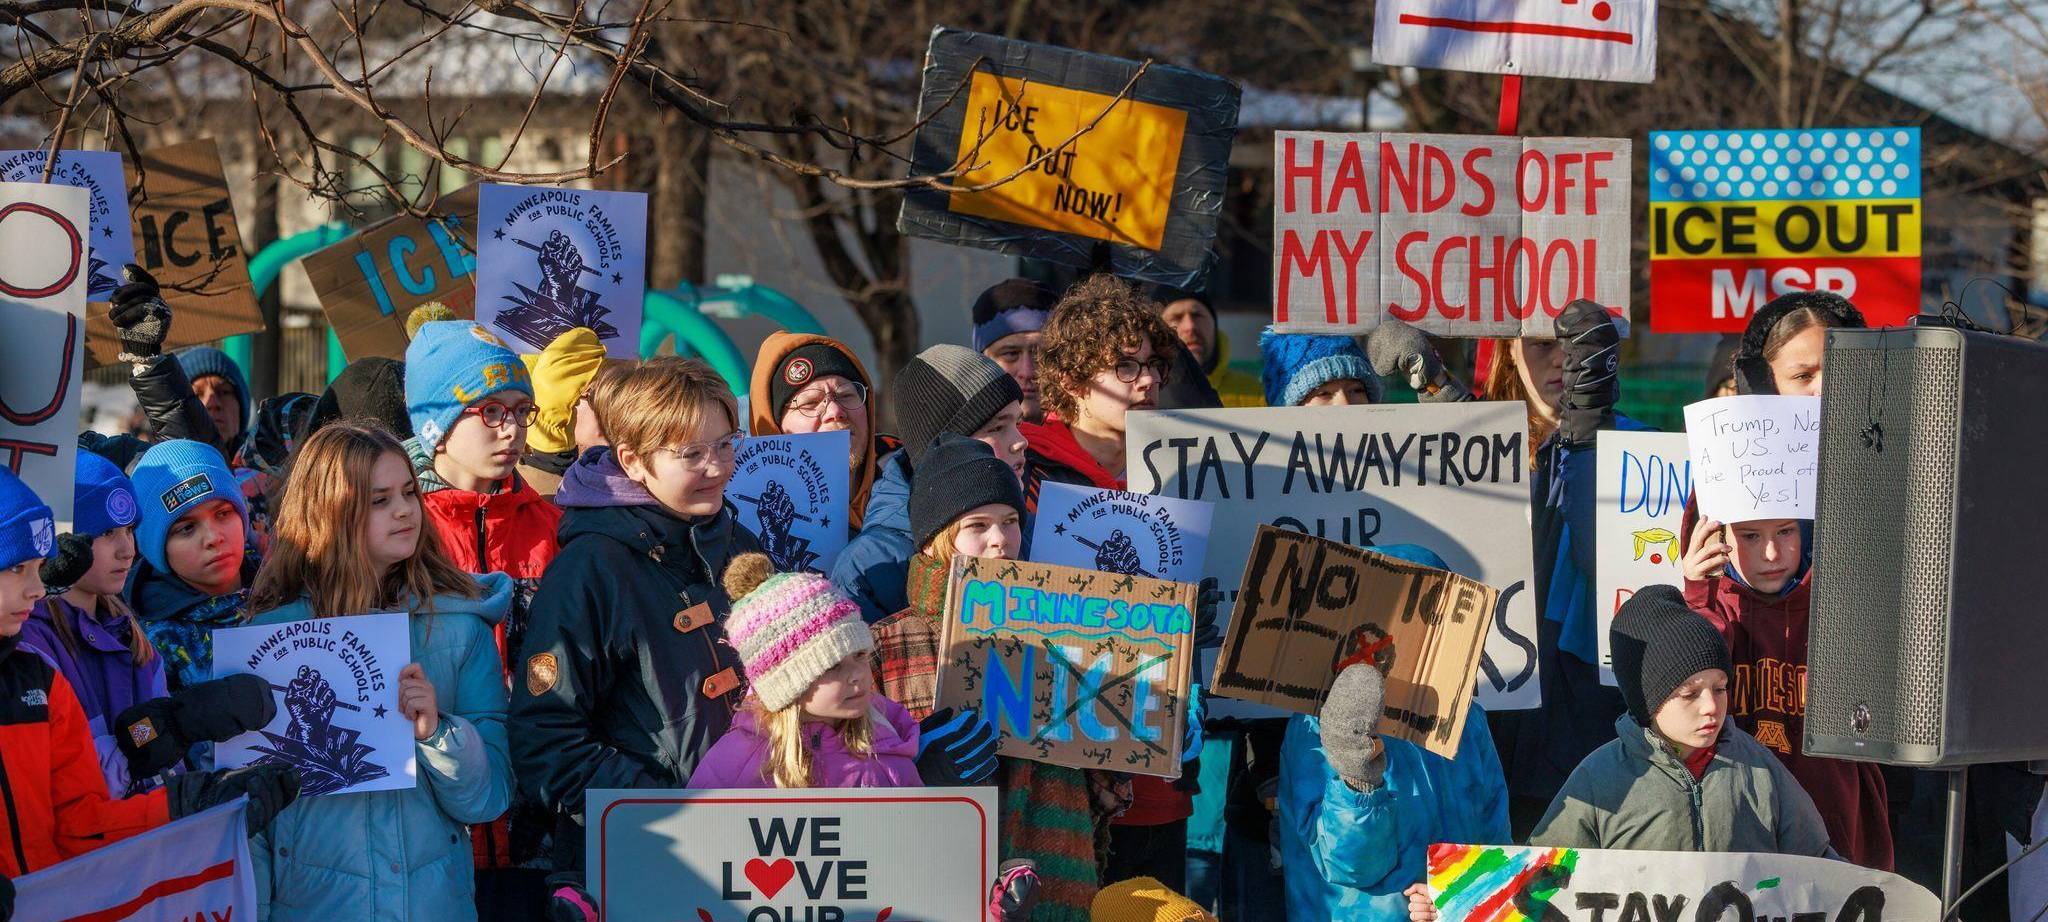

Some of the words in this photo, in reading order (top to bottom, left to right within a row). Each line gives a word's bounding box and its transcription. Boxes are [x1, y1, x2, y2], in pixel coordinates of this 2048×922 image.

[993, 100, 1039, 134] ICE
[71, 162, 110, 216] FAMILIES
[1026, 144, 1077, 179] OUT
[1284, 138, 1496, 217] HANDS
[1515, 148, 1614, 216] OFF
[139, 198, 238, 270] ICE
[505, 190, 581, 227] MINNEAPOLIS
[588, 204, 623, 261] FAMILIES
[1054, 184, 1123, 222] NOW!
[1655, 205, 1757, 255] ICE
[1774, 204, 1913, 254] OUT
[528, 210, 542, 221] FOR
[546, 205, 585, 222] PUBLIC
[585, 219, 610, 269] SCHOOLS
[1276, 230, 1374, 325] MY
[1388, 231, 1622, 322] SCHOOL
[1700, 408, 1780, 438] Trump,
[762, 454, 796, 468] PUBLIC
[796, 465, 818, 514] SCHOOLS
[799, 448, 830, 505] FAMILIES
[1141, 431, 1271, 500] STAY
[1282, 430, 1418, 495] AWAY
[1417, 430, 1523, 488] FROM
[1745, 479, 1799, 510] Yes!
[1796, 462, 1817, 476] of
[1068, 490, 1150, 523] MINNEAPOLIS
[1155, 506, 1183, 566] FAMILIES
[1092, 508, 1107, 519] FOR
[1112, 504, 1150, 523] PUBLIC
[1150, 522, 1168, 574] SCHOOLS
[961, 579, 1194, 635] MINNESOTA
[1271, 542, 1359, 617] NO
[247, 621, 331, 670] MINNEAPOLIS
[341, 630, 385, 692] FAMILIES
[273, 646, 289, 660] FOR
[293, 637, 336, 652] PUBLIC
[338, 648, 369, 703] SCHOOLS
[982, 644, 1168, 742] NICE
[748, 817, 841, 857] WE
